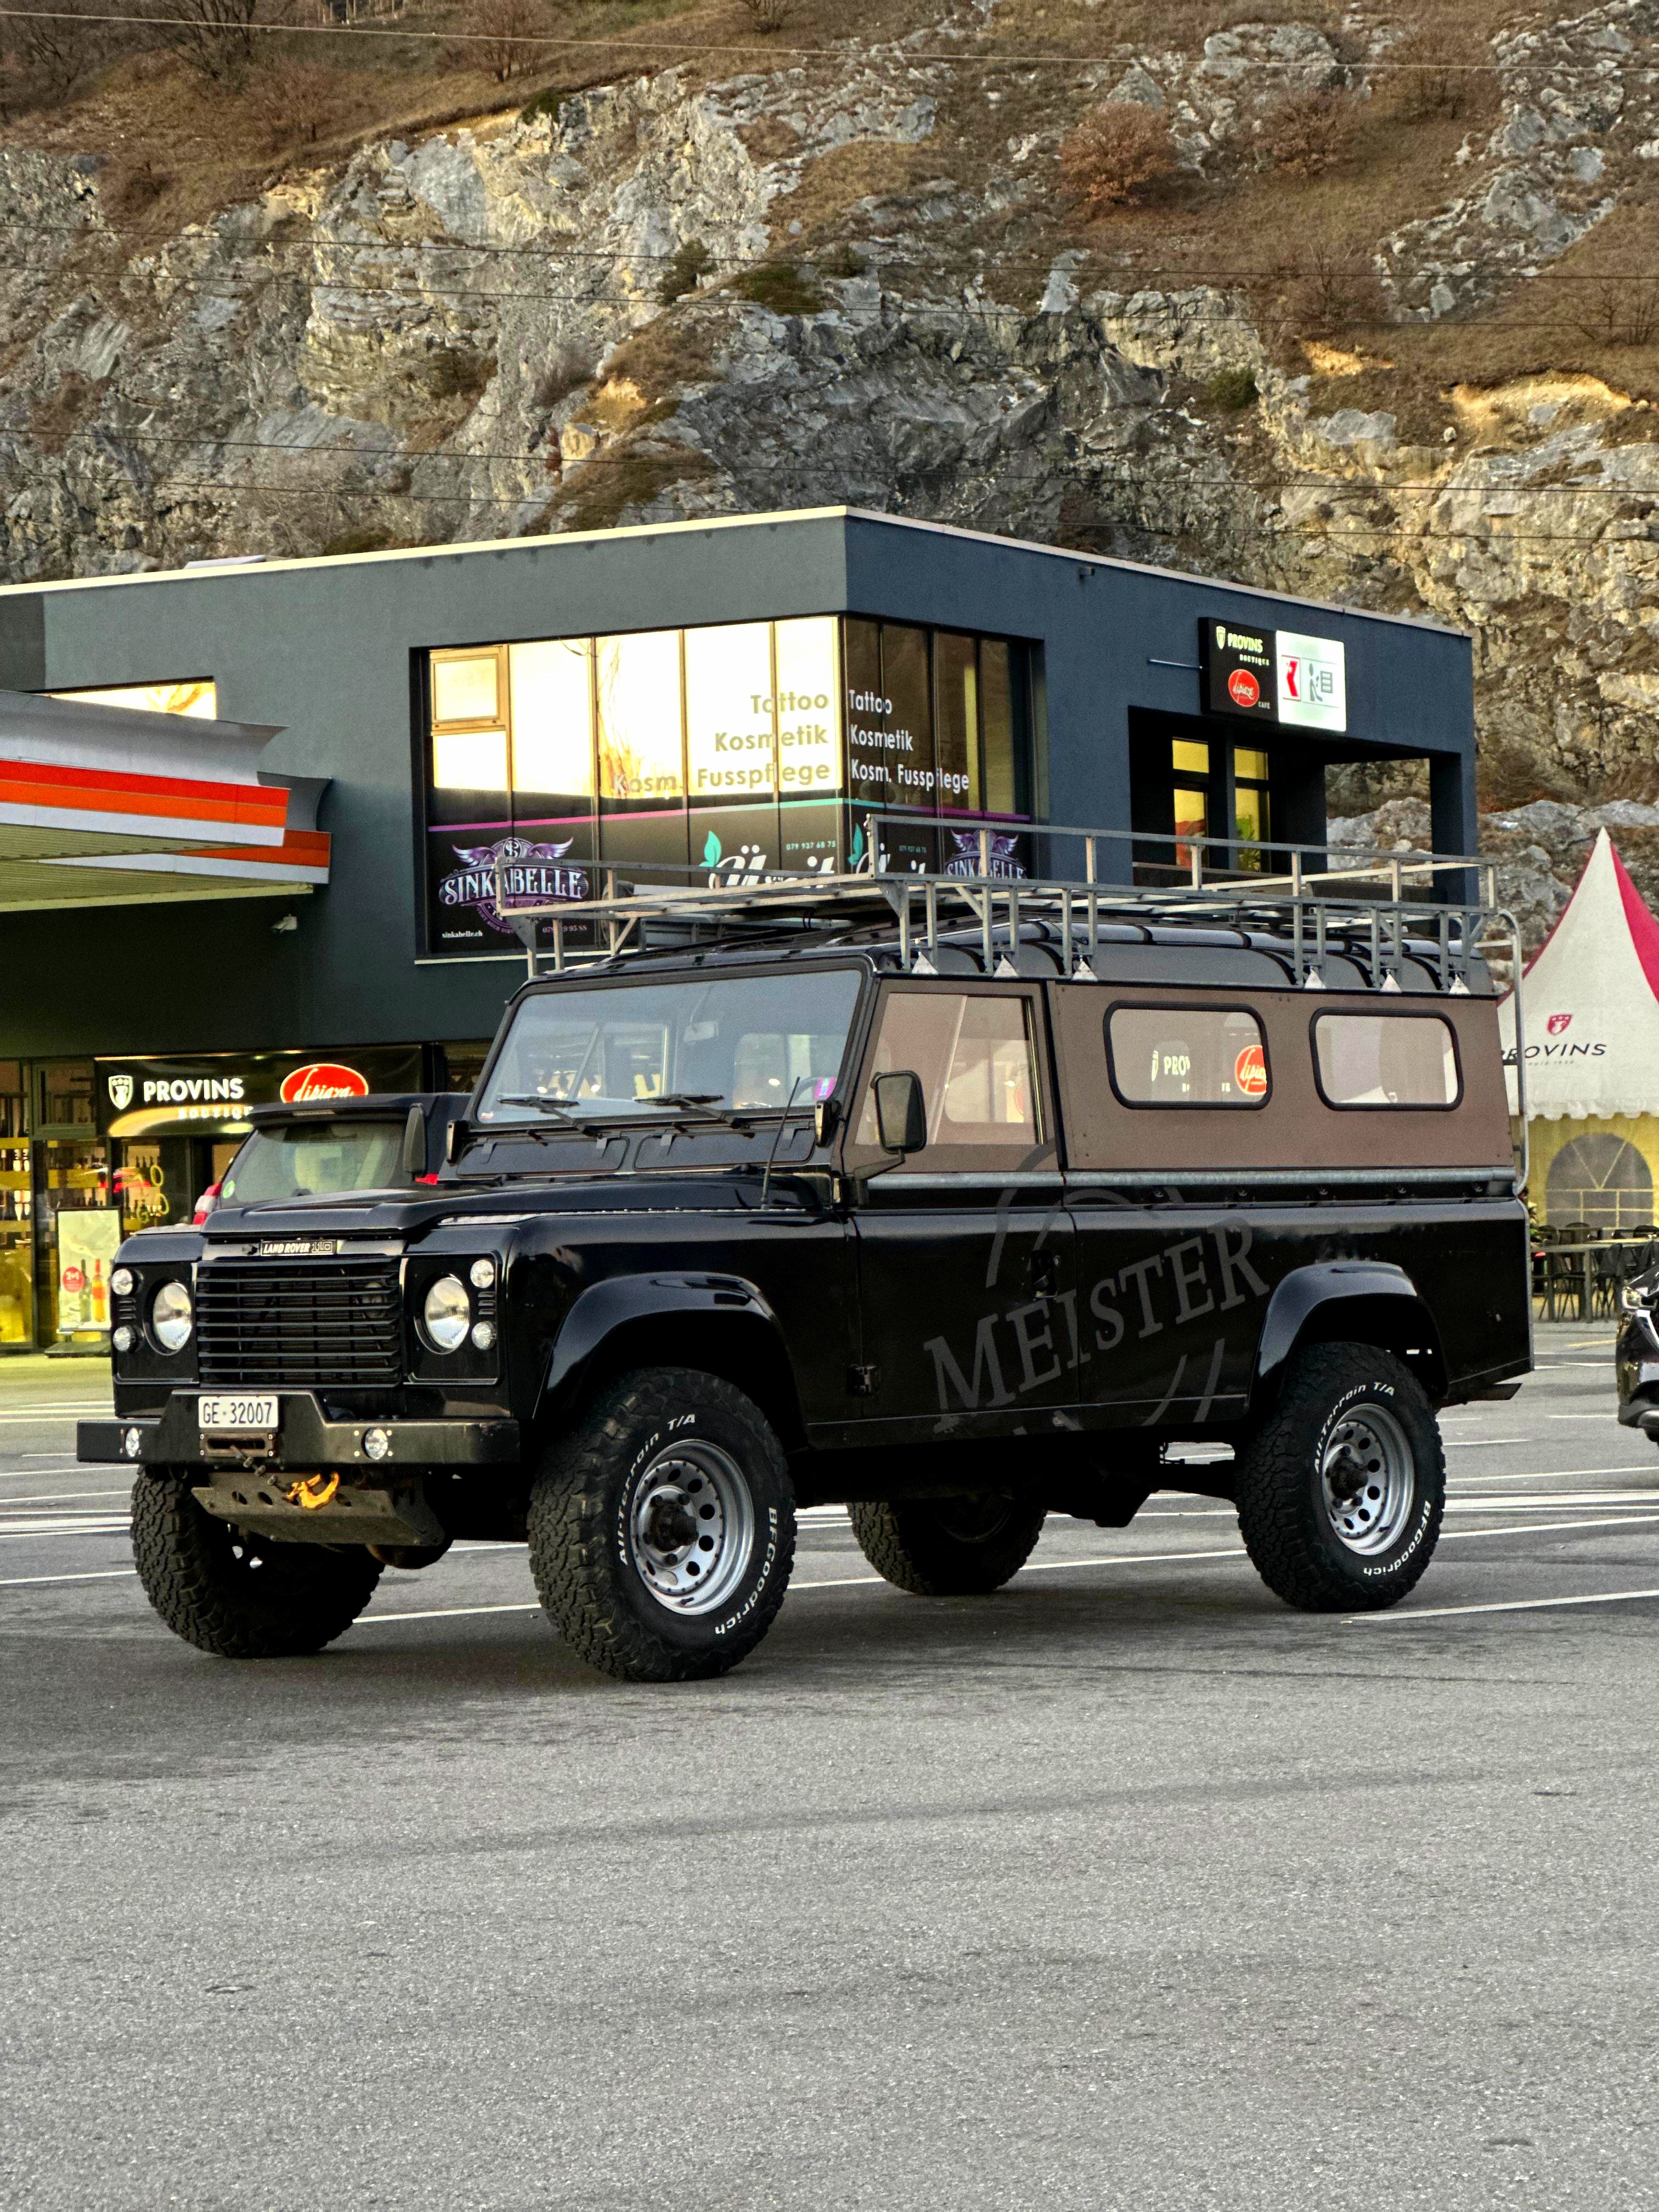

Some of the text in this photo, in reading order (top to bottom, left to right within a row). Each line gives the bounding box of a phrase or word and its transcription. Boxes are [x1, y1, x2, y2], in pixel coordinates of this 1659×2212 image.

[1228, 633, 1263, 653] PROVINS
[751, 691, 829, 714] Tattoo
[849, 689, 893, 714] Tattoo
[715, 724, 829, 752] Kosmetik
[850, 724, 913, 751] Kosmetik
[698, 763, 830, 788] Fusspflege
[851, 759, 892, 782] Kosm.
[144, 1078, 244, 1102] PROVINS
[263, 1241, 333, 1254] LAND ROVER 110
[923, 1217, 1269, 1433] MEISTER
[1373, 1381, 1395, 1397] T/A
[203, 1402, 272, 1424] GE 32007
[668, 1413, 696, 1431] T/A
[1363, 1500, 1431, 1576] BFGoodrich
[715, 1507, 777, 1634] BFGoodrich
